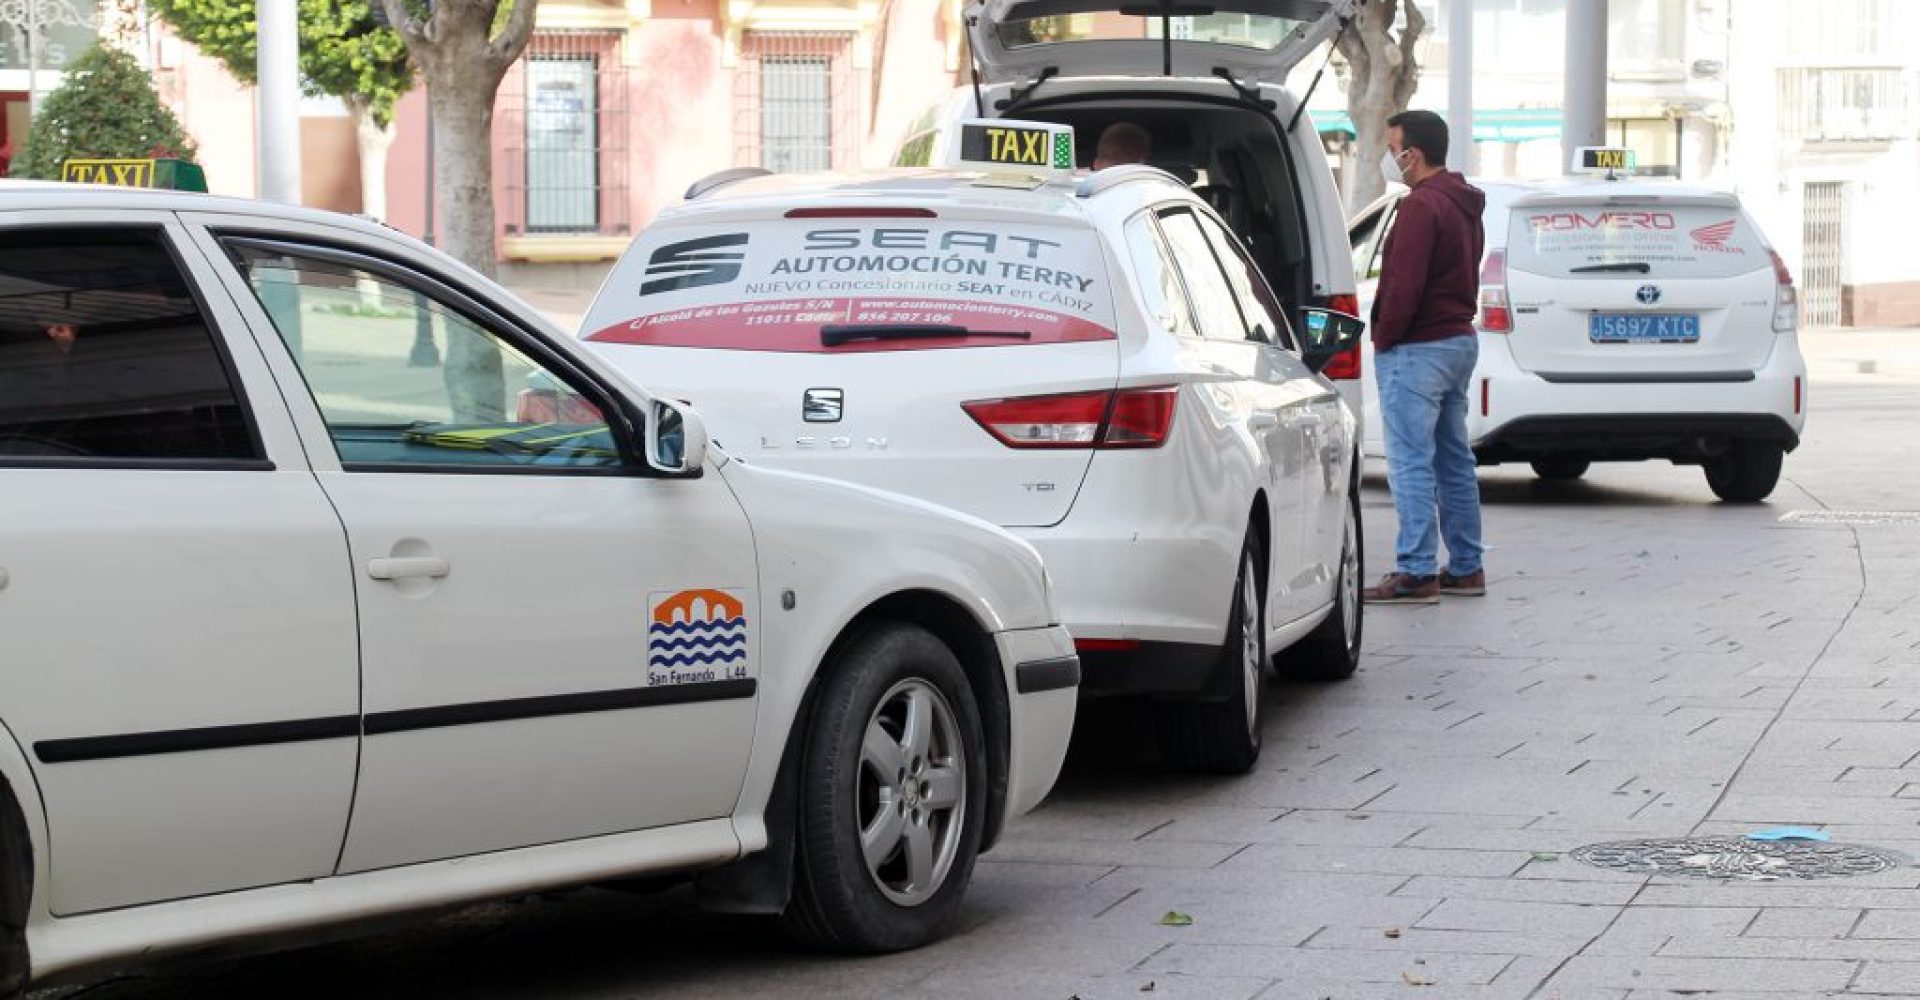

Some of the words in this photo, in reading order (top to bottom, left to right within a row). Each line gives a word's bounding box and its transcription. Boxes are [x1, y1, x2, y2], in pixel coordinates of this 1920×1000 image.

[986, 128, 1048, 163] TAXI
[1595, 151, 1627, 168] TAXI
[71, 164, 148, 187] TAXI
[1529, 212, 1676, 231] ROMERO
[804, 228, 1062, 259] SEAT
[770, 252, 987, 275] AUTOMOCIÓN
[998, 261, 1094, 293] TERRY
[745, 280, 811, 294] NUEVO
[817, 278, 951, 292] Concesionario
[956, 281, 1006, 296] SEAT
[1010, 289, 1033, 300] en
[1038, 289, 1094, 313] CÁDIZ
[1604, 317, 1650, 335] 5697
[1657, 317, 1694, 335] KTC
[648, 671, 668, 685] San
[670, 666, 715, 684] Fernando
